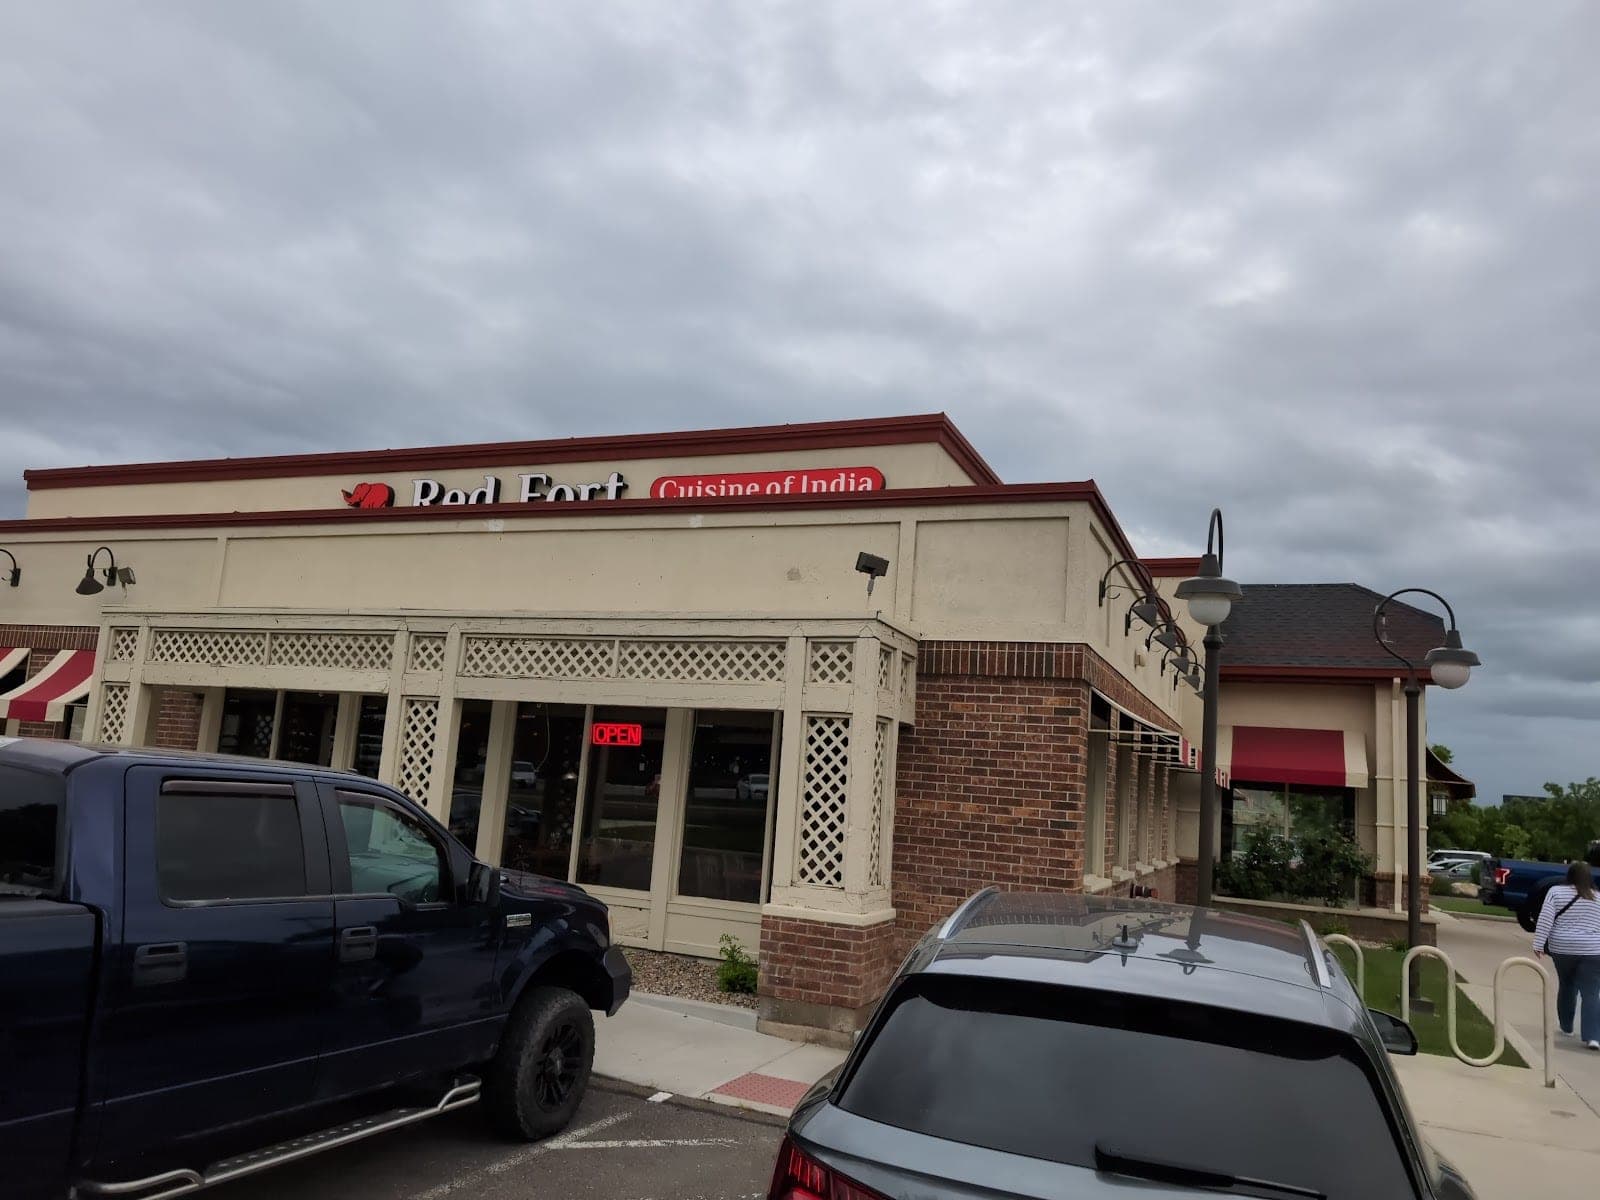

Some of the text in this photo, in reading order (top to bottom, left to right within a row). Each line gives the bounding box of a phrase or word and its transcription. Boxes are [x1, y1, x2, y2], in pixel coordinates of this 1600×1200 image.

[412, 472, 624, 507] Red Fort
[659, 472, 873, 498] Cuisine of India
[595, 726, 639, 743] OPEN
